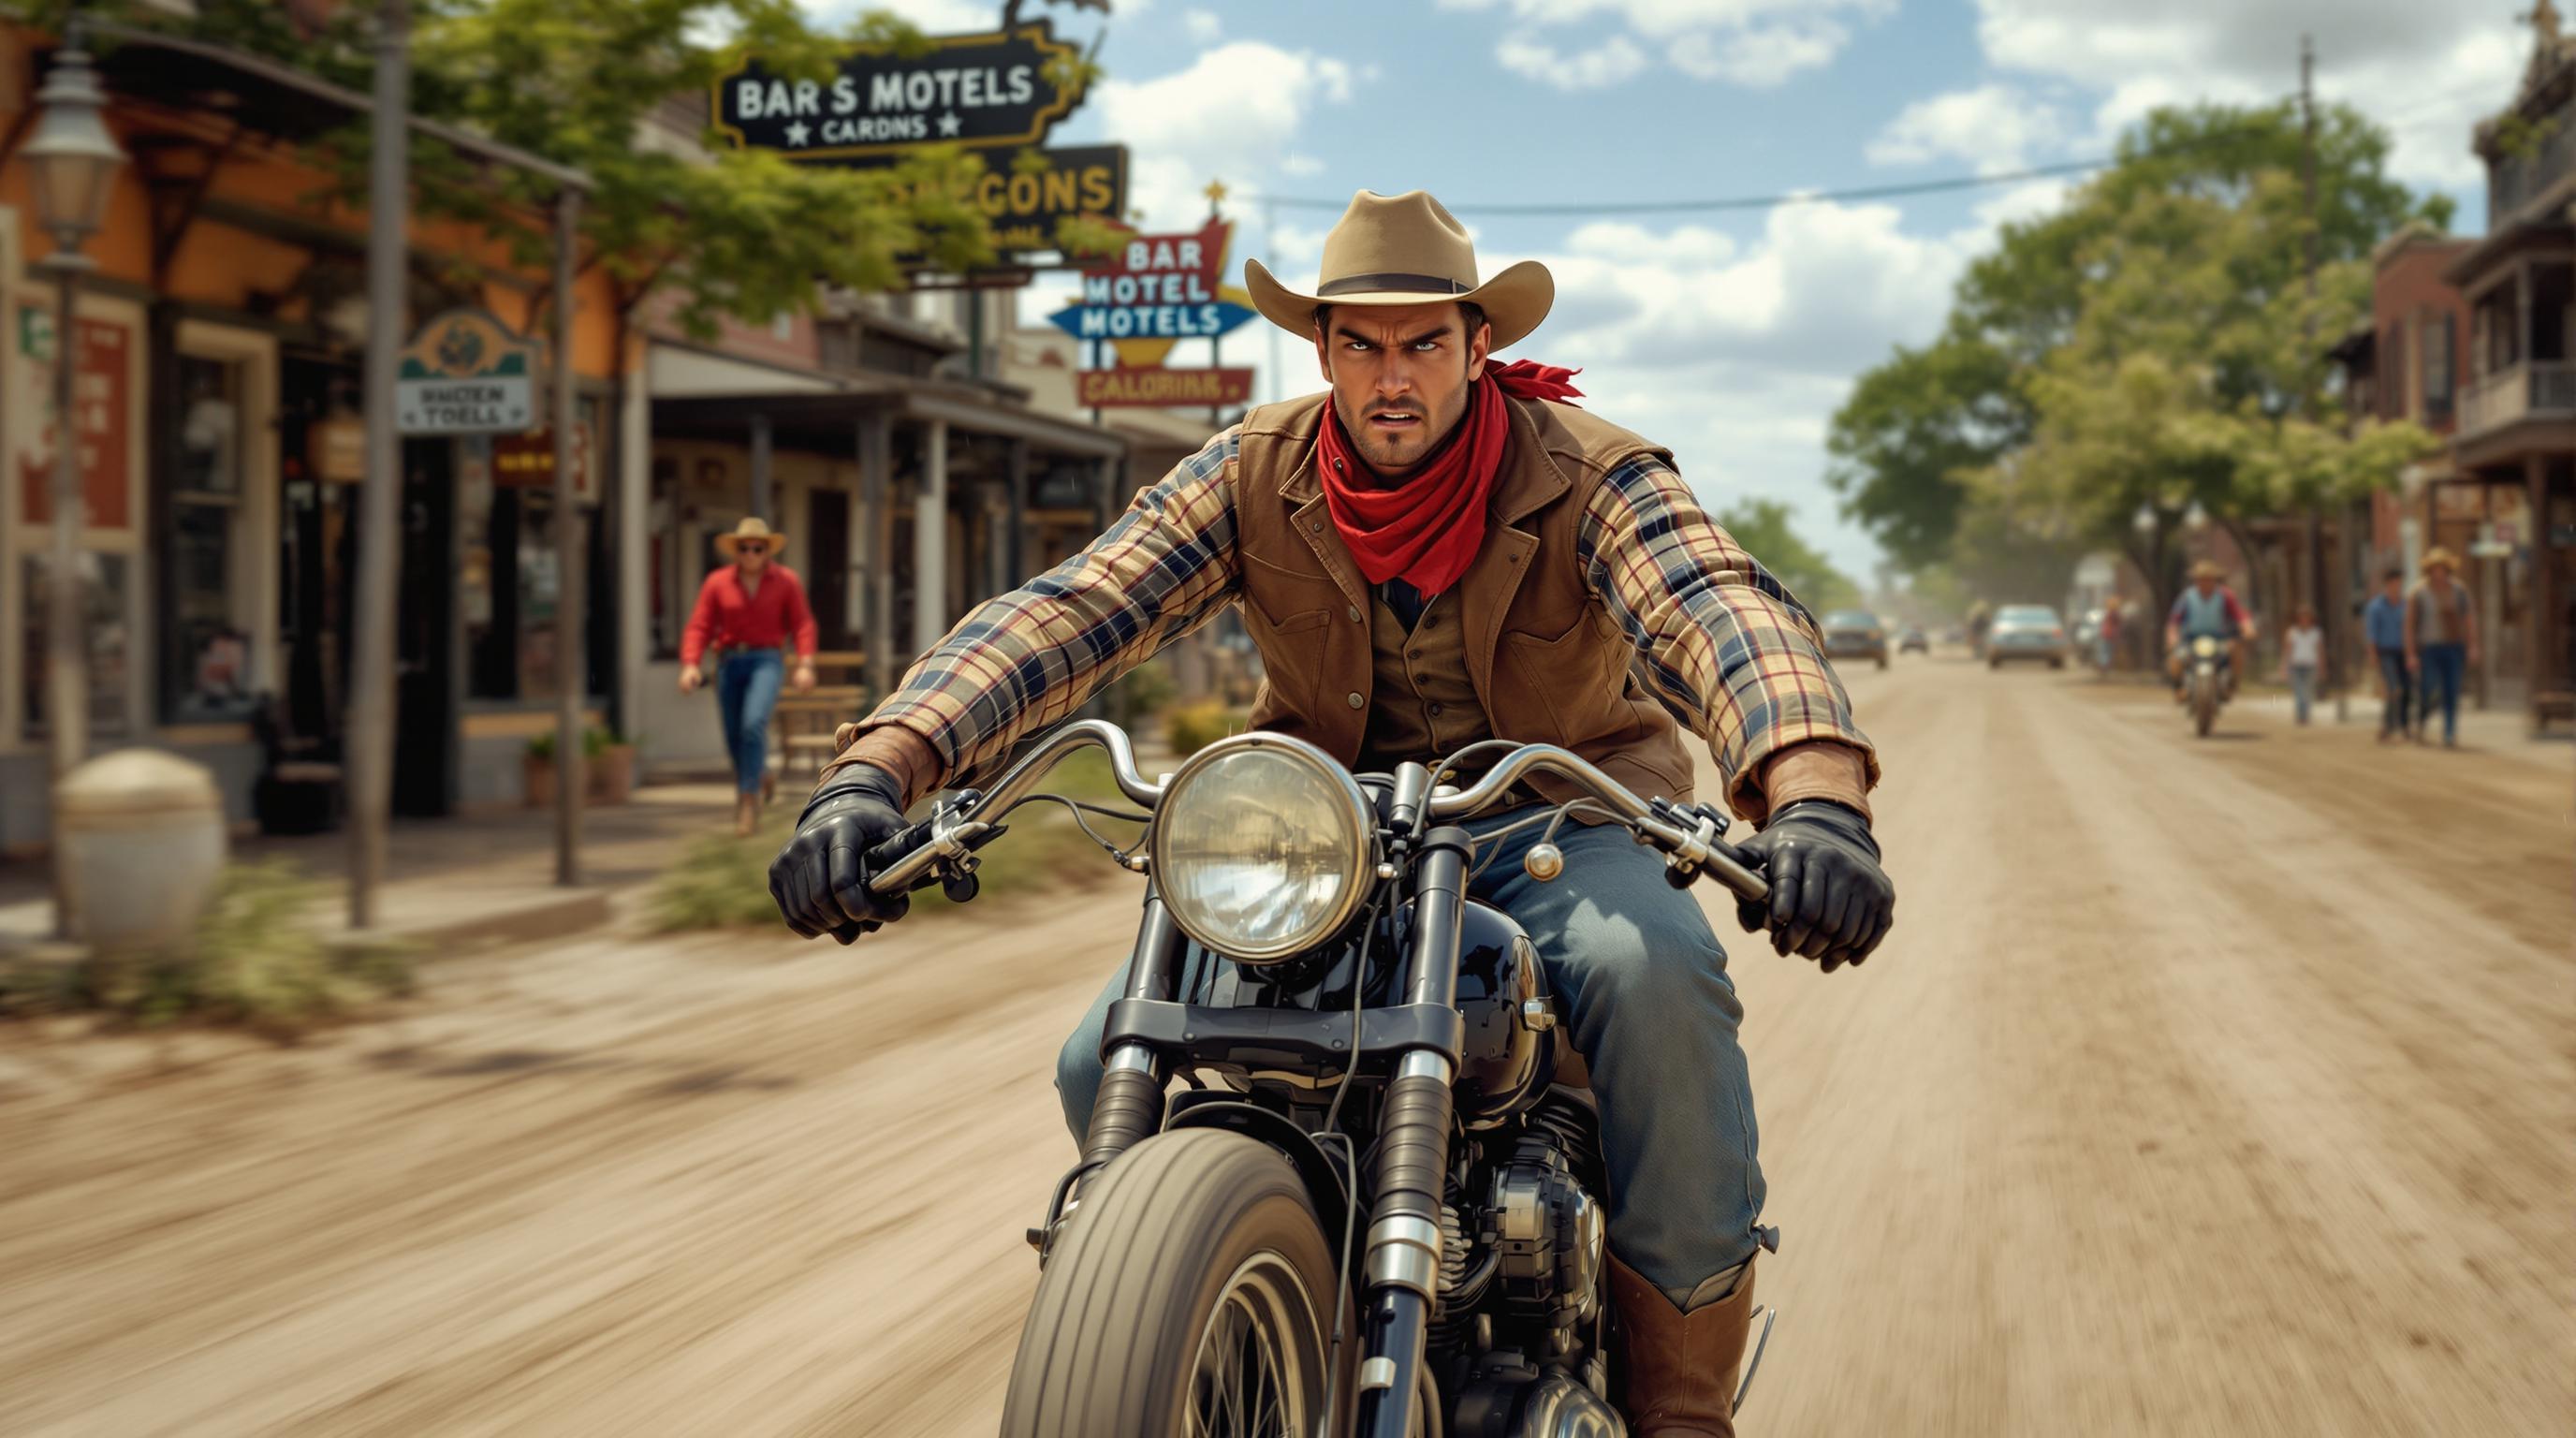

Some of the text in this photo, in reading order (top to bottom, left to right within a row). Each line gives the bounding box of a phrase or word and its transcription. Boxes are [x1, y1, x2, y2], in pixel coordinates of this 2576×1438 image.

[870, 65, 1034, 111] MOTELS
[1127, 240, 1203, 271] BAR
[1084, 273, 1210, 305] MOTEL
[1080, 304, 1222, 337] MOTELS
